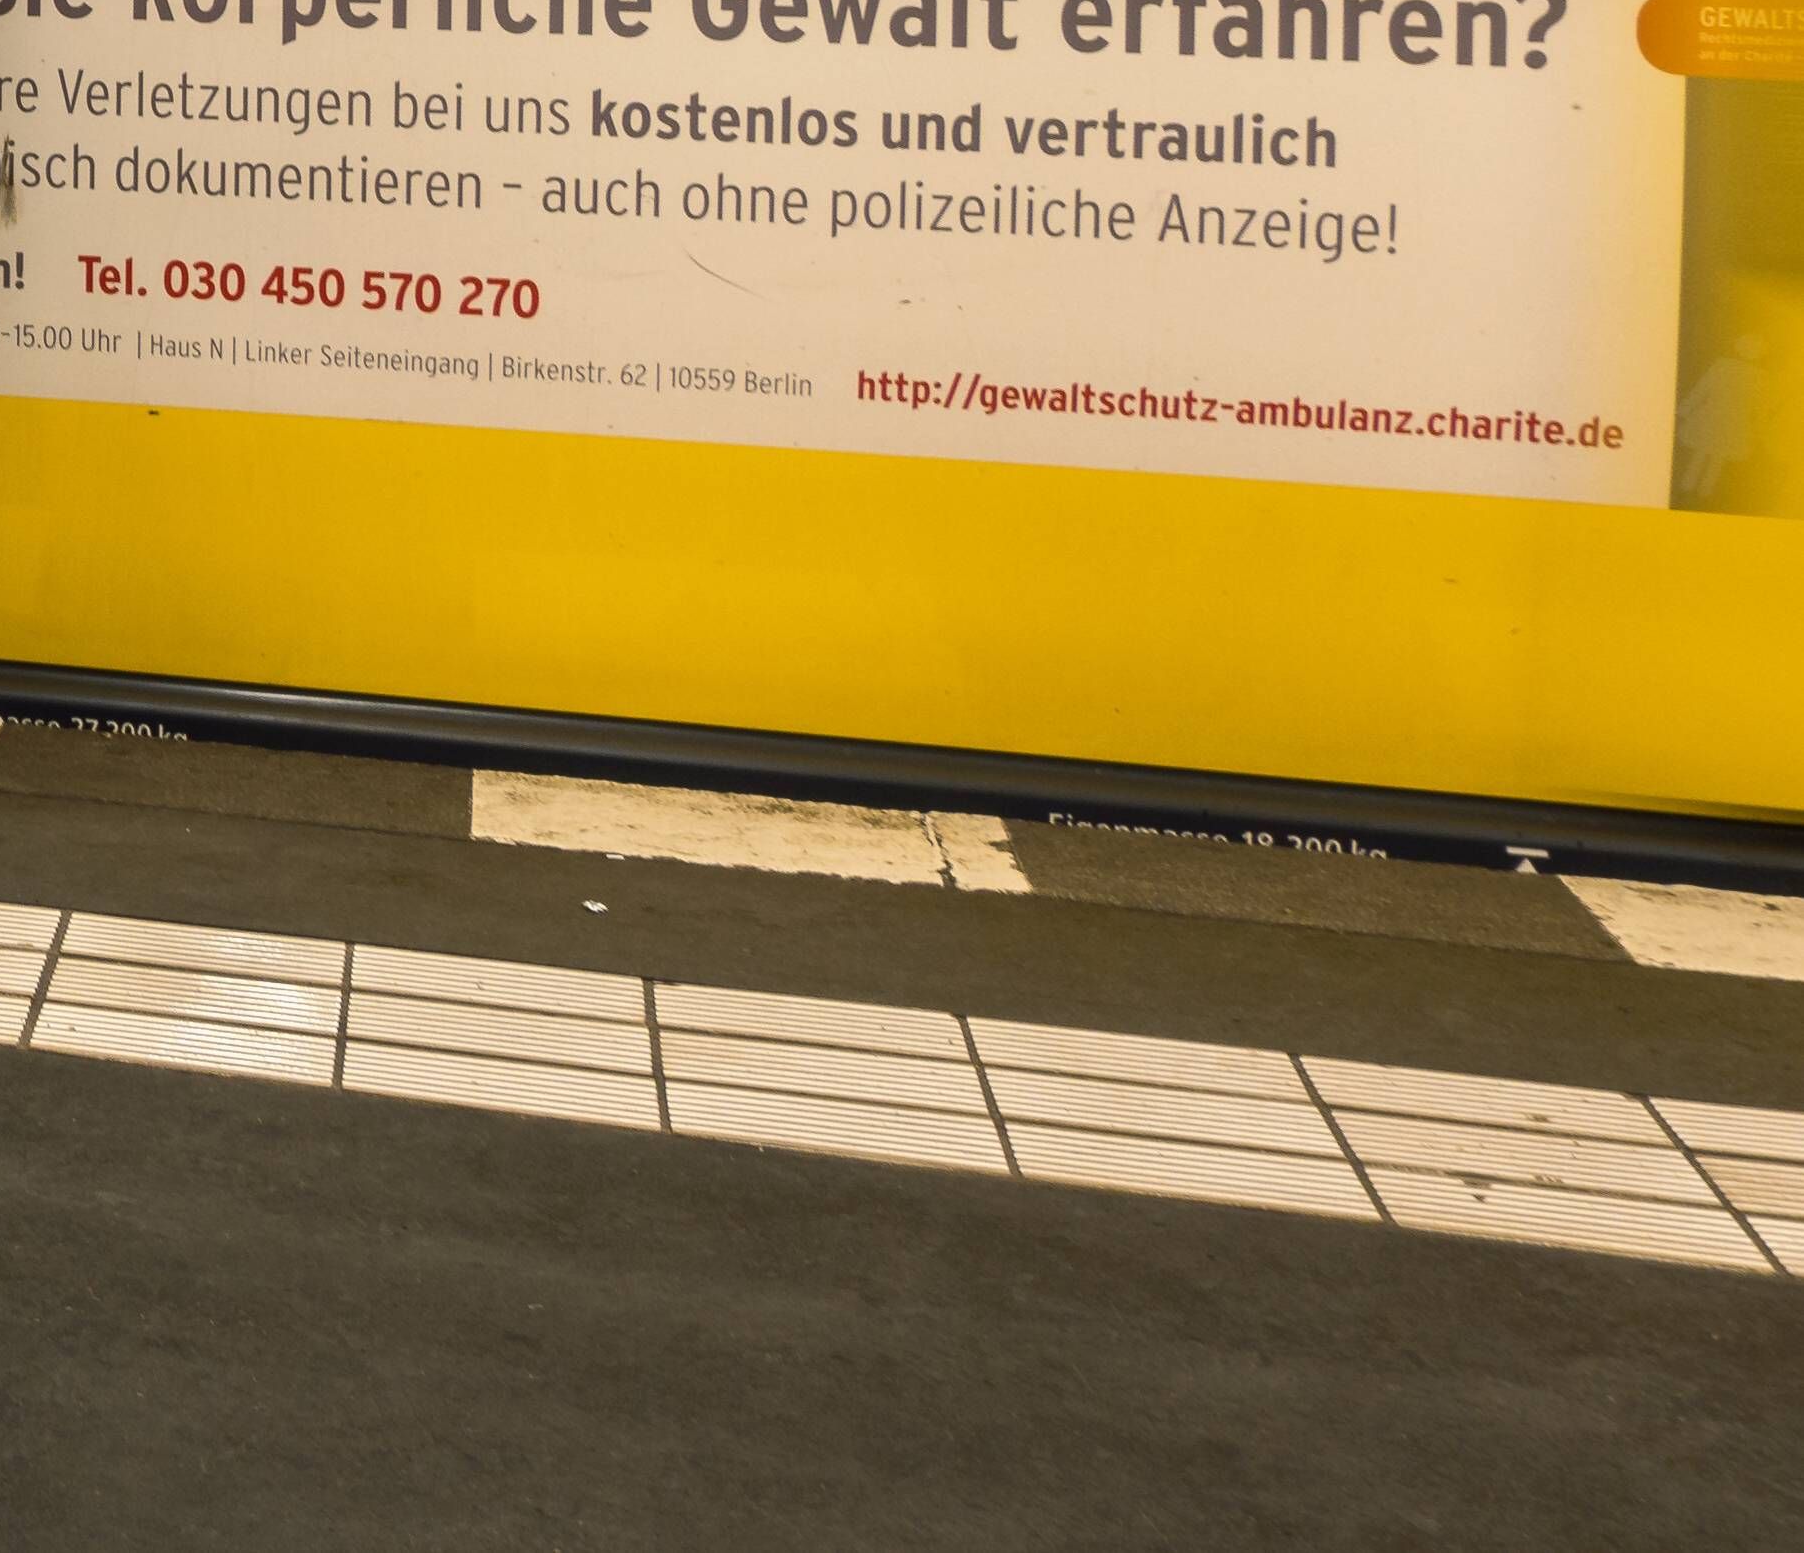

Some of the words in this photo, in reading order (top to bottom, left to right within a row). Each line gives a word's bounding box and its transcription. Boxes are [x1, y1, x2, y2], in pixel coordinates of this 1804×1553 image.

[58, 68, 371, 136] Verletzungen
[394, 80, 462, 131] bei
[486, 96, 569, 135] uns
[592, 88, 858, 147] kostenlos
[882, 103, 981, 152] und
[1005, 108, 1336, 168] vertraulich
[116, 145, 481, 209] dokumentieren
[542, 168, 659, 217] auch
[683, 172, 808, 225] ohne
[831, 181, 1135, 240] polizeiliche
[1158, 194, 1396, 263] Anzeige!
[78, 255, 147, 297] Tel.
[164, 259, 245, 302] 030
[261, 266, 345, 308] 450
[362, 270, 441, 314] 570
[459, 276, 540, 319] 270
[82, 328, 121, 353] Uhr
[150, 335, 203, 359] Haus
[211, 338, 222, 359] N
[246, 340, 312, 365] Linker
[321, 345, 478, 380] Seiteneingang
[503, 356, 611, 384] Birkenstr.
[621, 364, 646, 386] 62
[671, 367, 735, 390] 10559
[745, 371, 811, 396] Berlin
[858, 370, 1623, 449] http://gewaltschutz-ambulanz.charite.de
